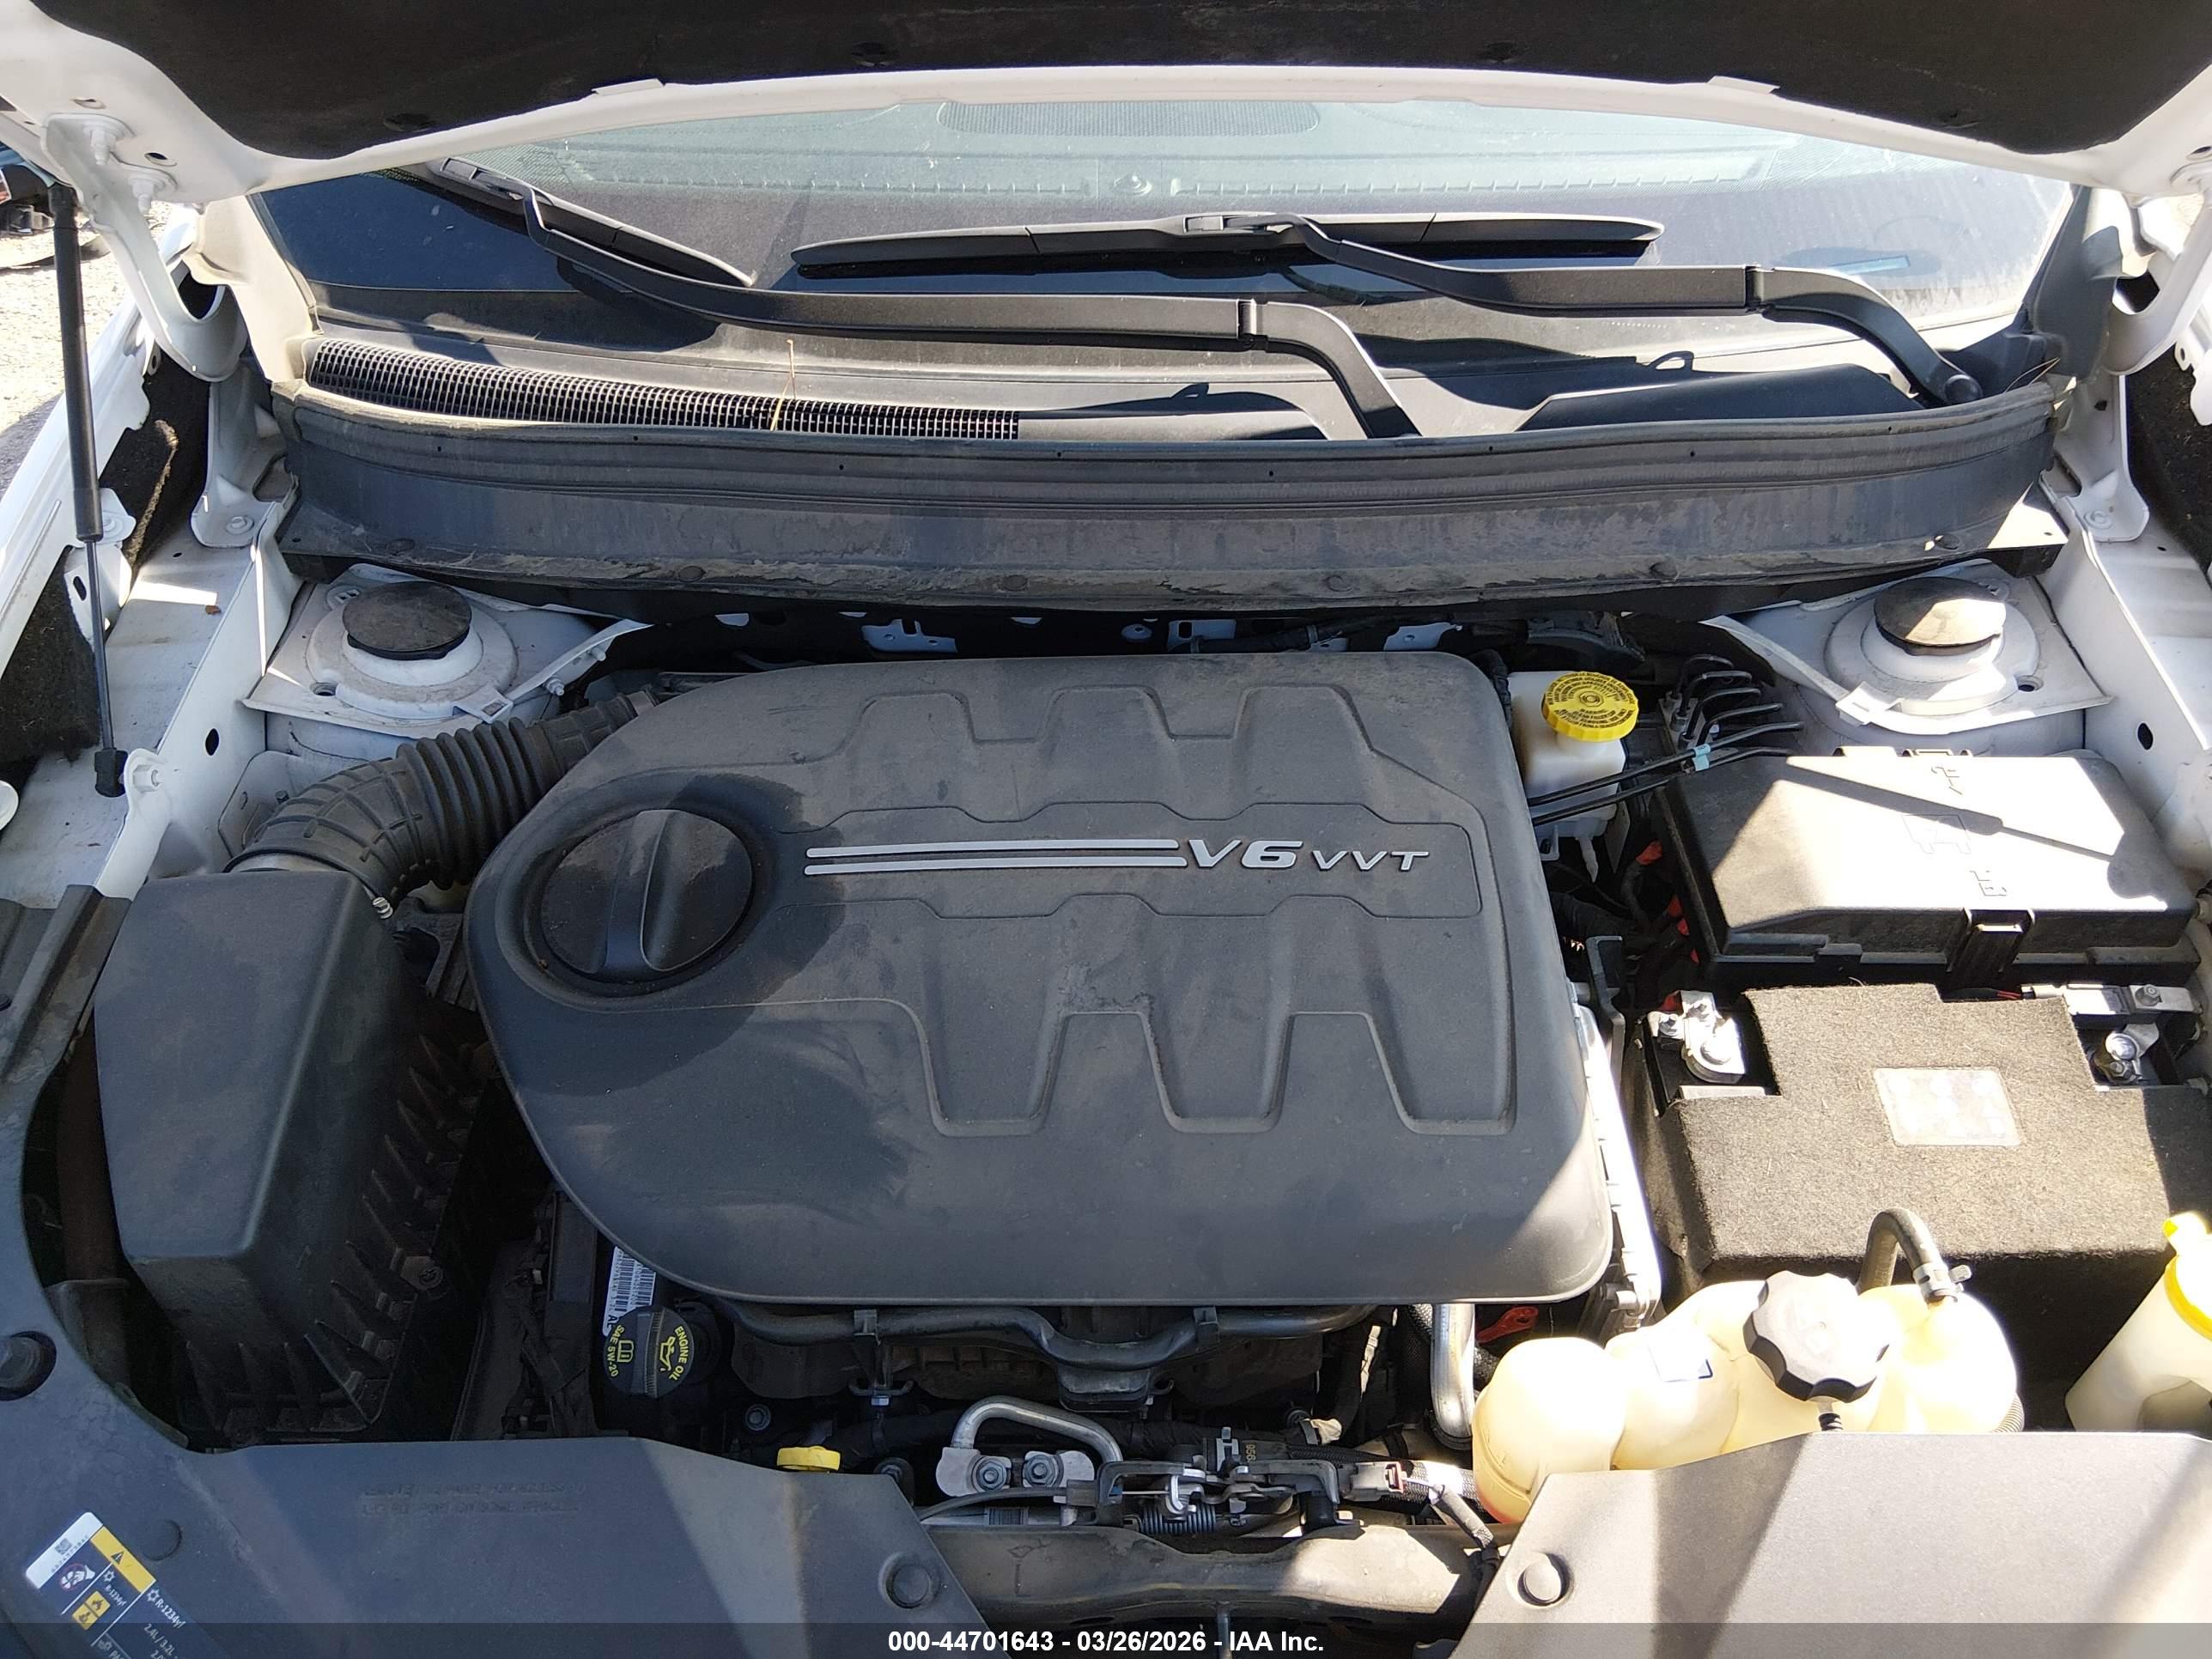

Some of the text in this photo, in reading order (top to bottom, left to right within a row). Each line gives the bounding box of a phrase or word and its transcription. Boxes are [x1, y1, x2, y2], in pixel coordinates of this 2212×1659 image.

[1188, 839, 1429, 872] V6 VVT
[607, 1325, 625, 1377] SAE 5W-20
[669, 1326, 690, 1381] ENGINE OIL
[160, 1639, 175, 1656] 3.2L
